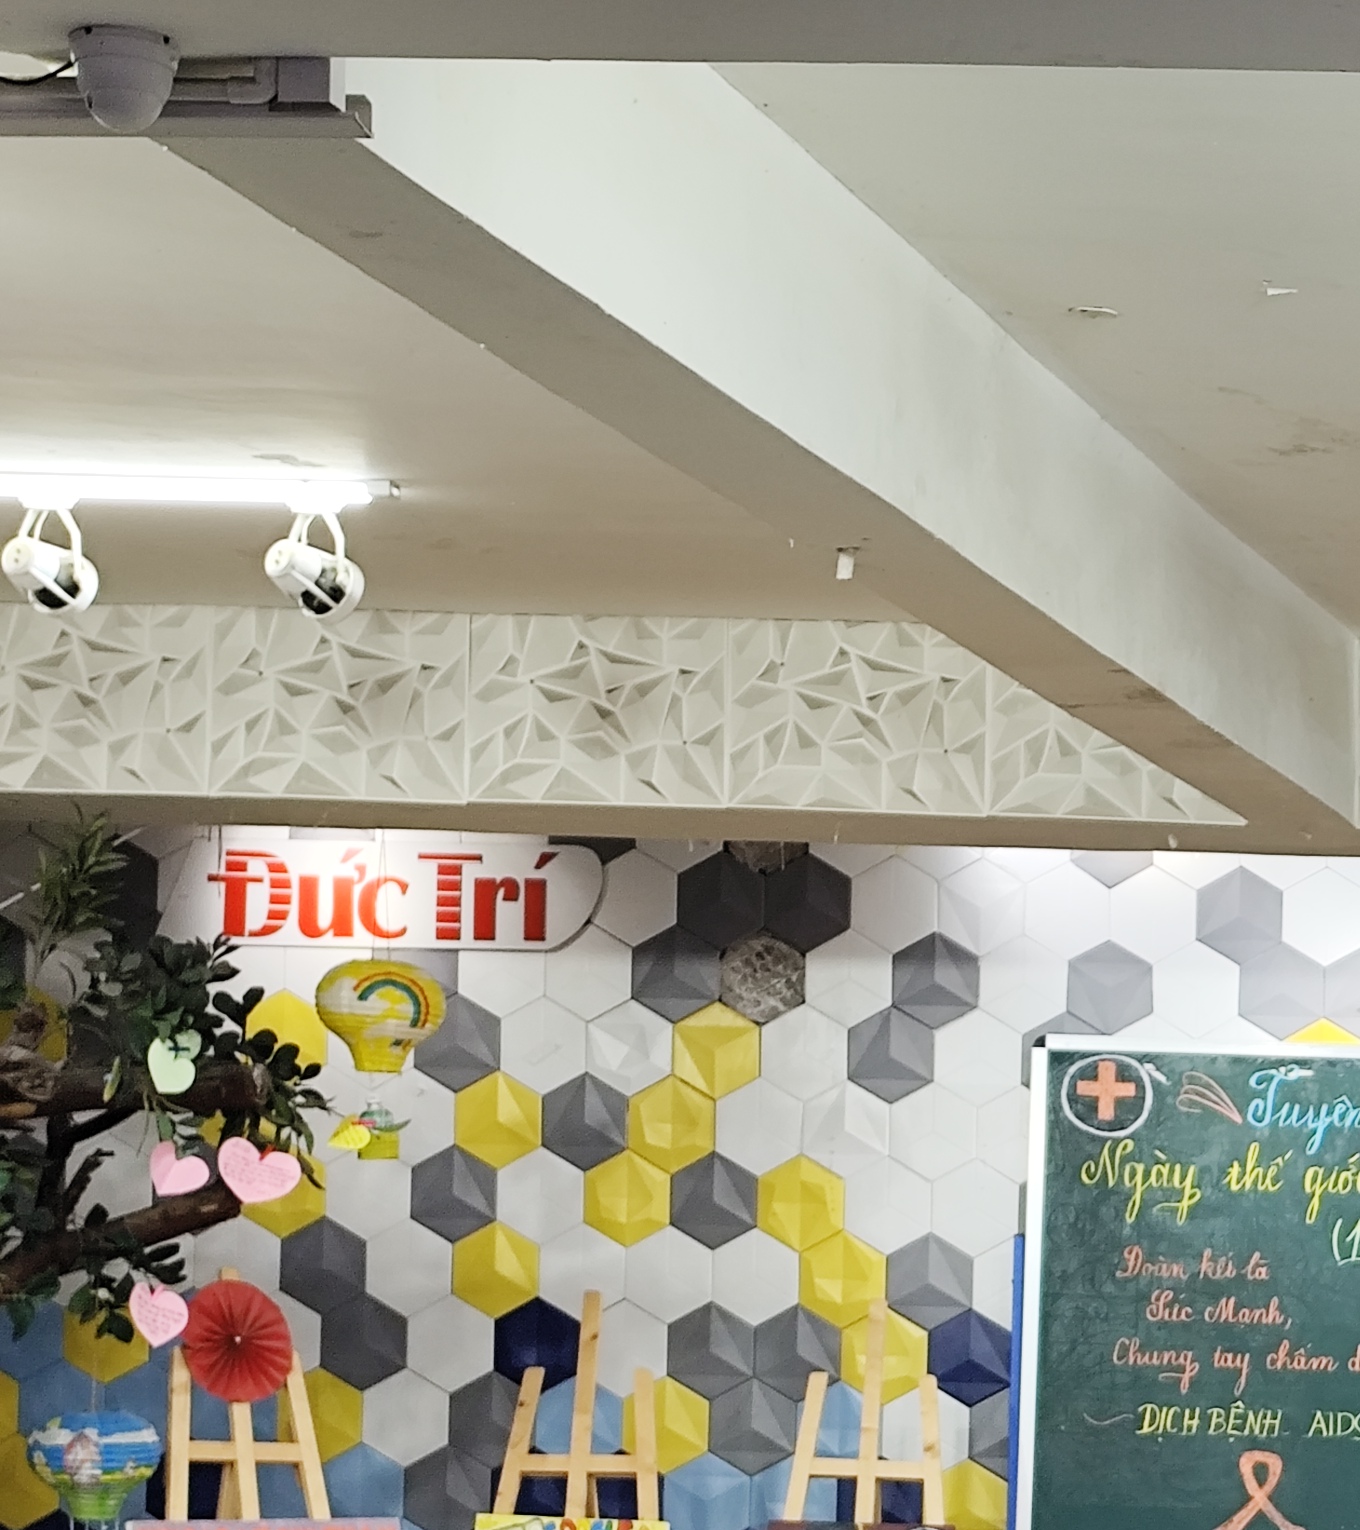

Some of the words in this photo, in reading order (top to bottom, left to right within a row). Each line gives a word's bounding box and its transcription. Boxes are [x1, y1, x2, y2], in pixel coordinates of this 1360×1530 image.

[207, 847, 409, 938] Đức
[418, 851, 561, 941] Trí
[1081, 1138, 1201, 1226] Ngày
[1222, 1141, 1294, 1191] thế
[1113, 1337, 1200, 1395] Chung
[1213, 1345, 1250, 1397] tay
[1266, 1339, 1340, 1372] chấm
[1135, 1402, 1200, 1443] DỊCH
[1207, 1399, 1284, 1443] BỆNH
